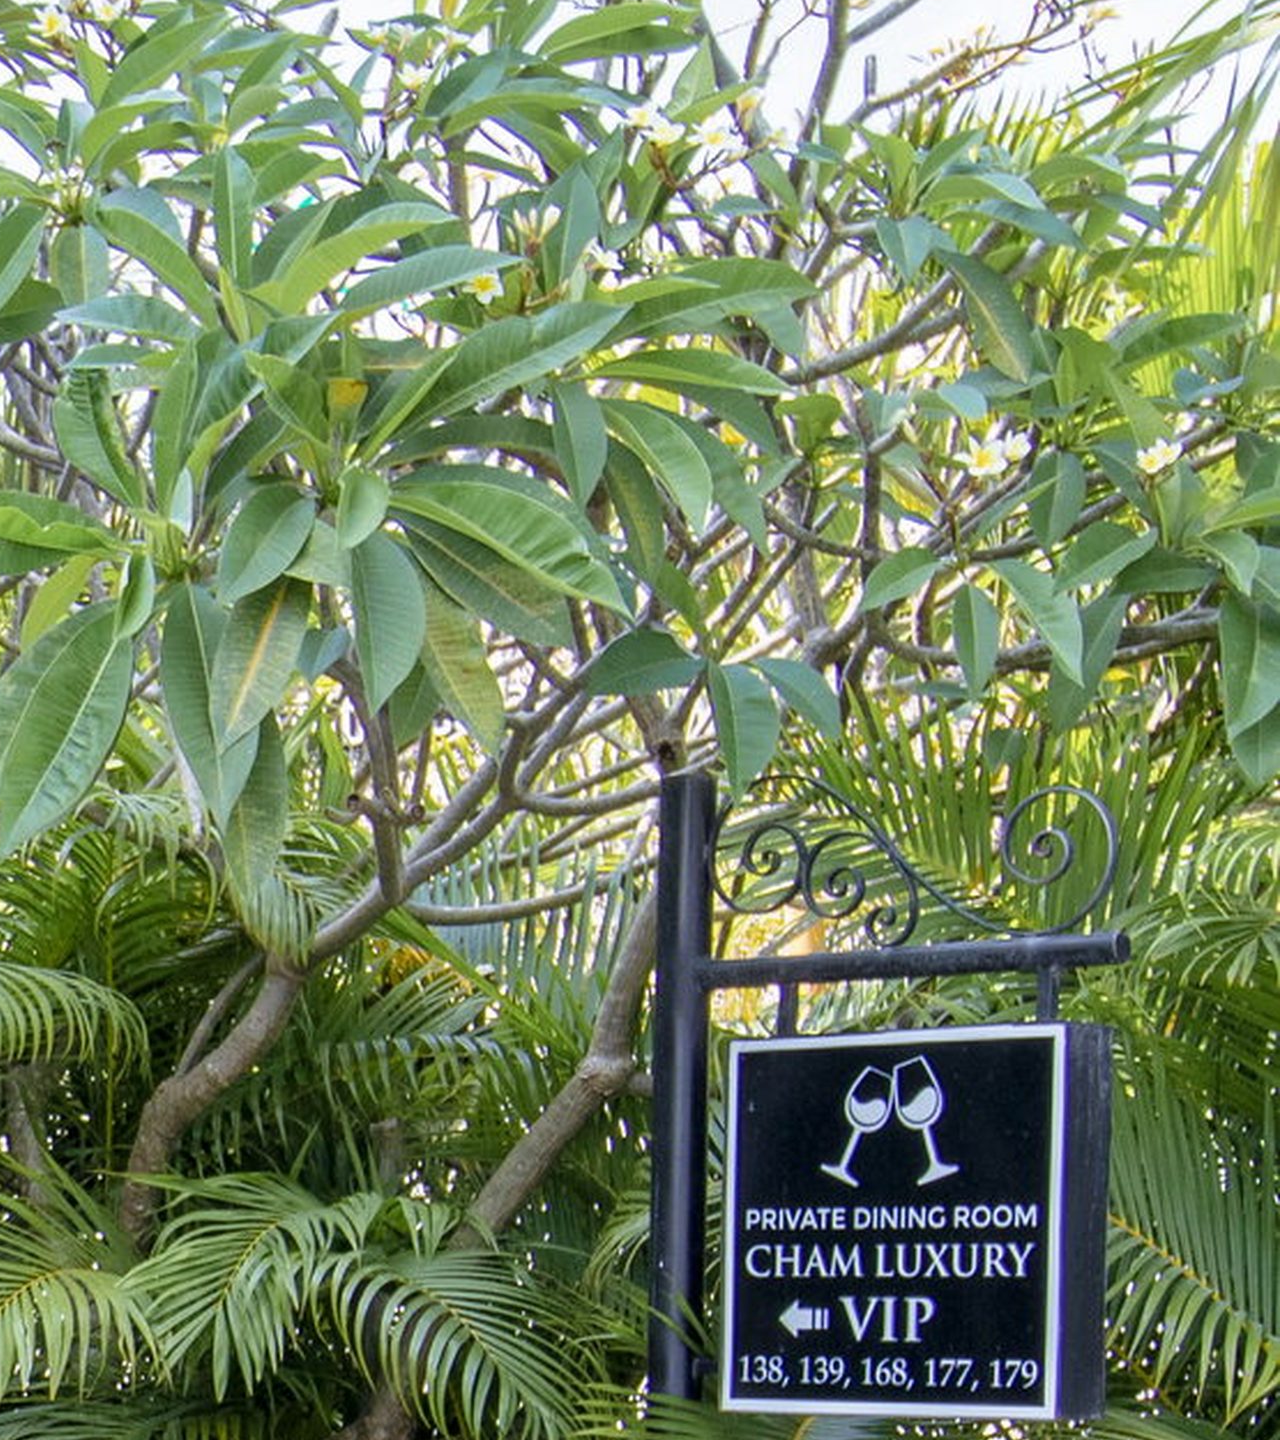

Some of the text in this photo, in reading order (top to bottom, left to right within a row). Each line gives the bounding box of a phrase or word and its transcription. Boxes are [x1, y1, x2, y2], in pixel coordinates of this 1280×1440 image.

[745, 1203, 1038, 1231] PRIVATE DINING ROOM
[744, 1242, 1036, 1278] CHAM LUXURY
[838, 1296, 936, 1343] VIP
[739, 1355, 1039, 1392] 138, 139, 168, 177, 179
